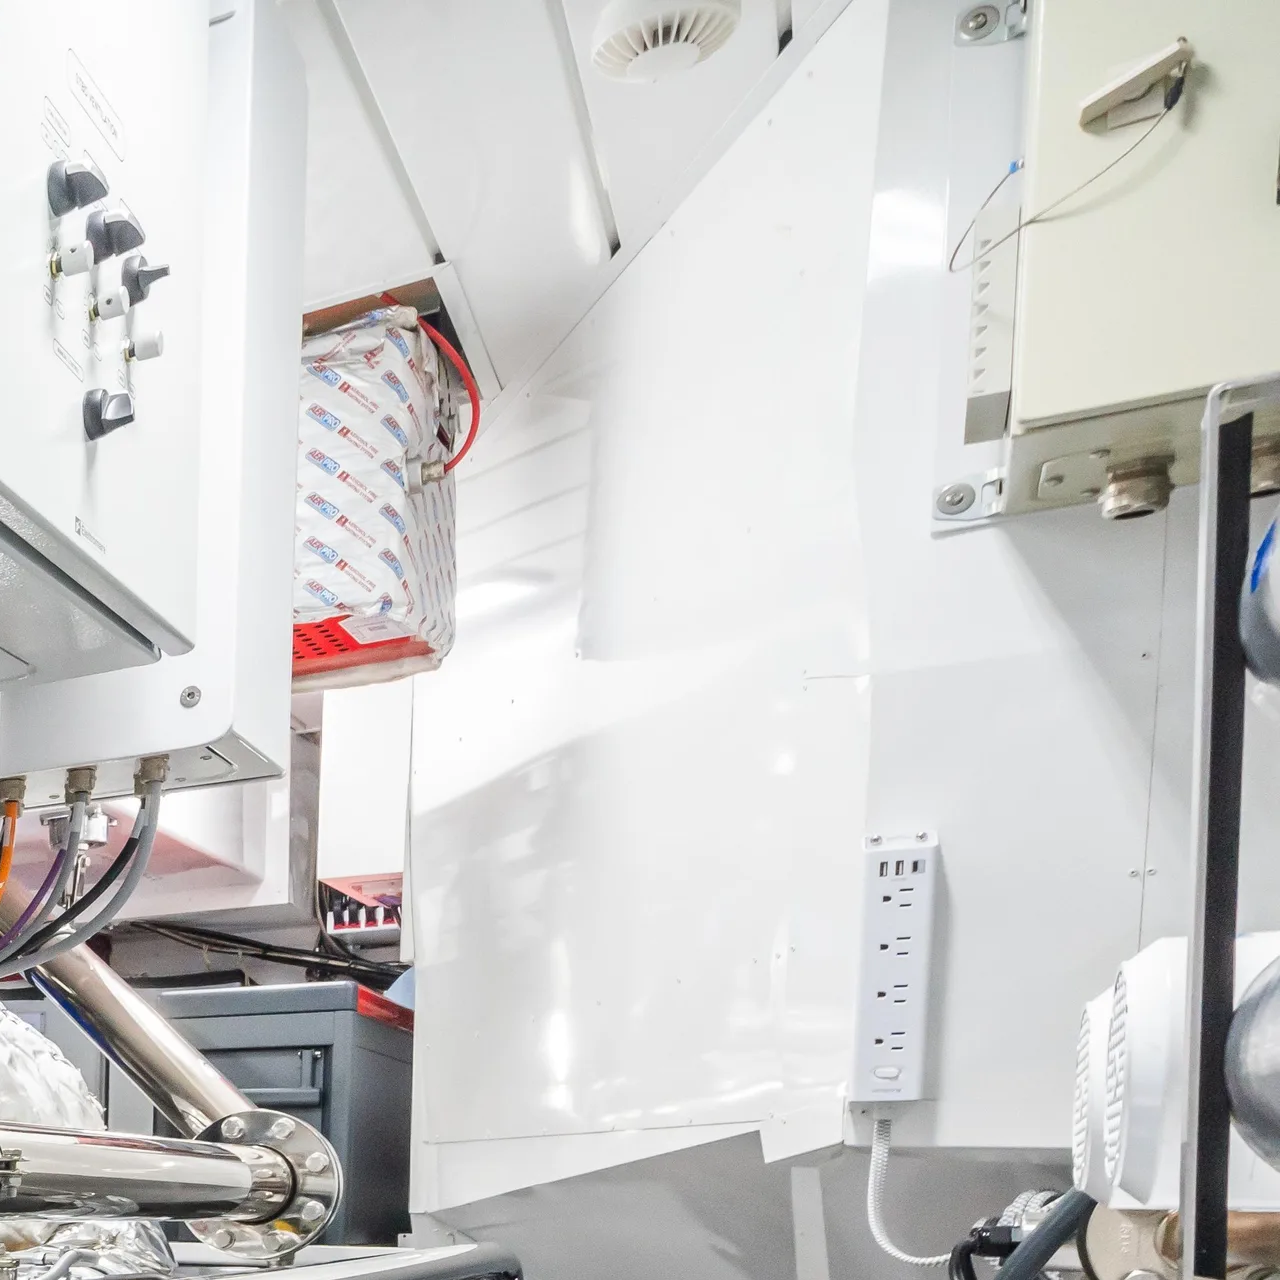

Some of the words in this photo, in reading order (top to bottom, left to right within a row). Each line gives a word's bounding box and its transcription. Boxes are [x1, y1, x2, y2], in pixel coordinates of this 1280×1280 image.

[324, 368, 340, 383] PRO
[309, 404, 326, 417] AER
[322, 413, 340, 428] PRO
[308, 448, 325, 462] AER
[322, 458, 340, 472] PRO
[308, 493, 324, 506] AER
[321, 502, 339, 516] PRO
[384, 504, 398, 518] AER
[306, 536, 323, 550] AER
[320, 546, 338, 560] PRO
[306, 580, 323, 593] AER
[320, 589, 338, 603] PRO
